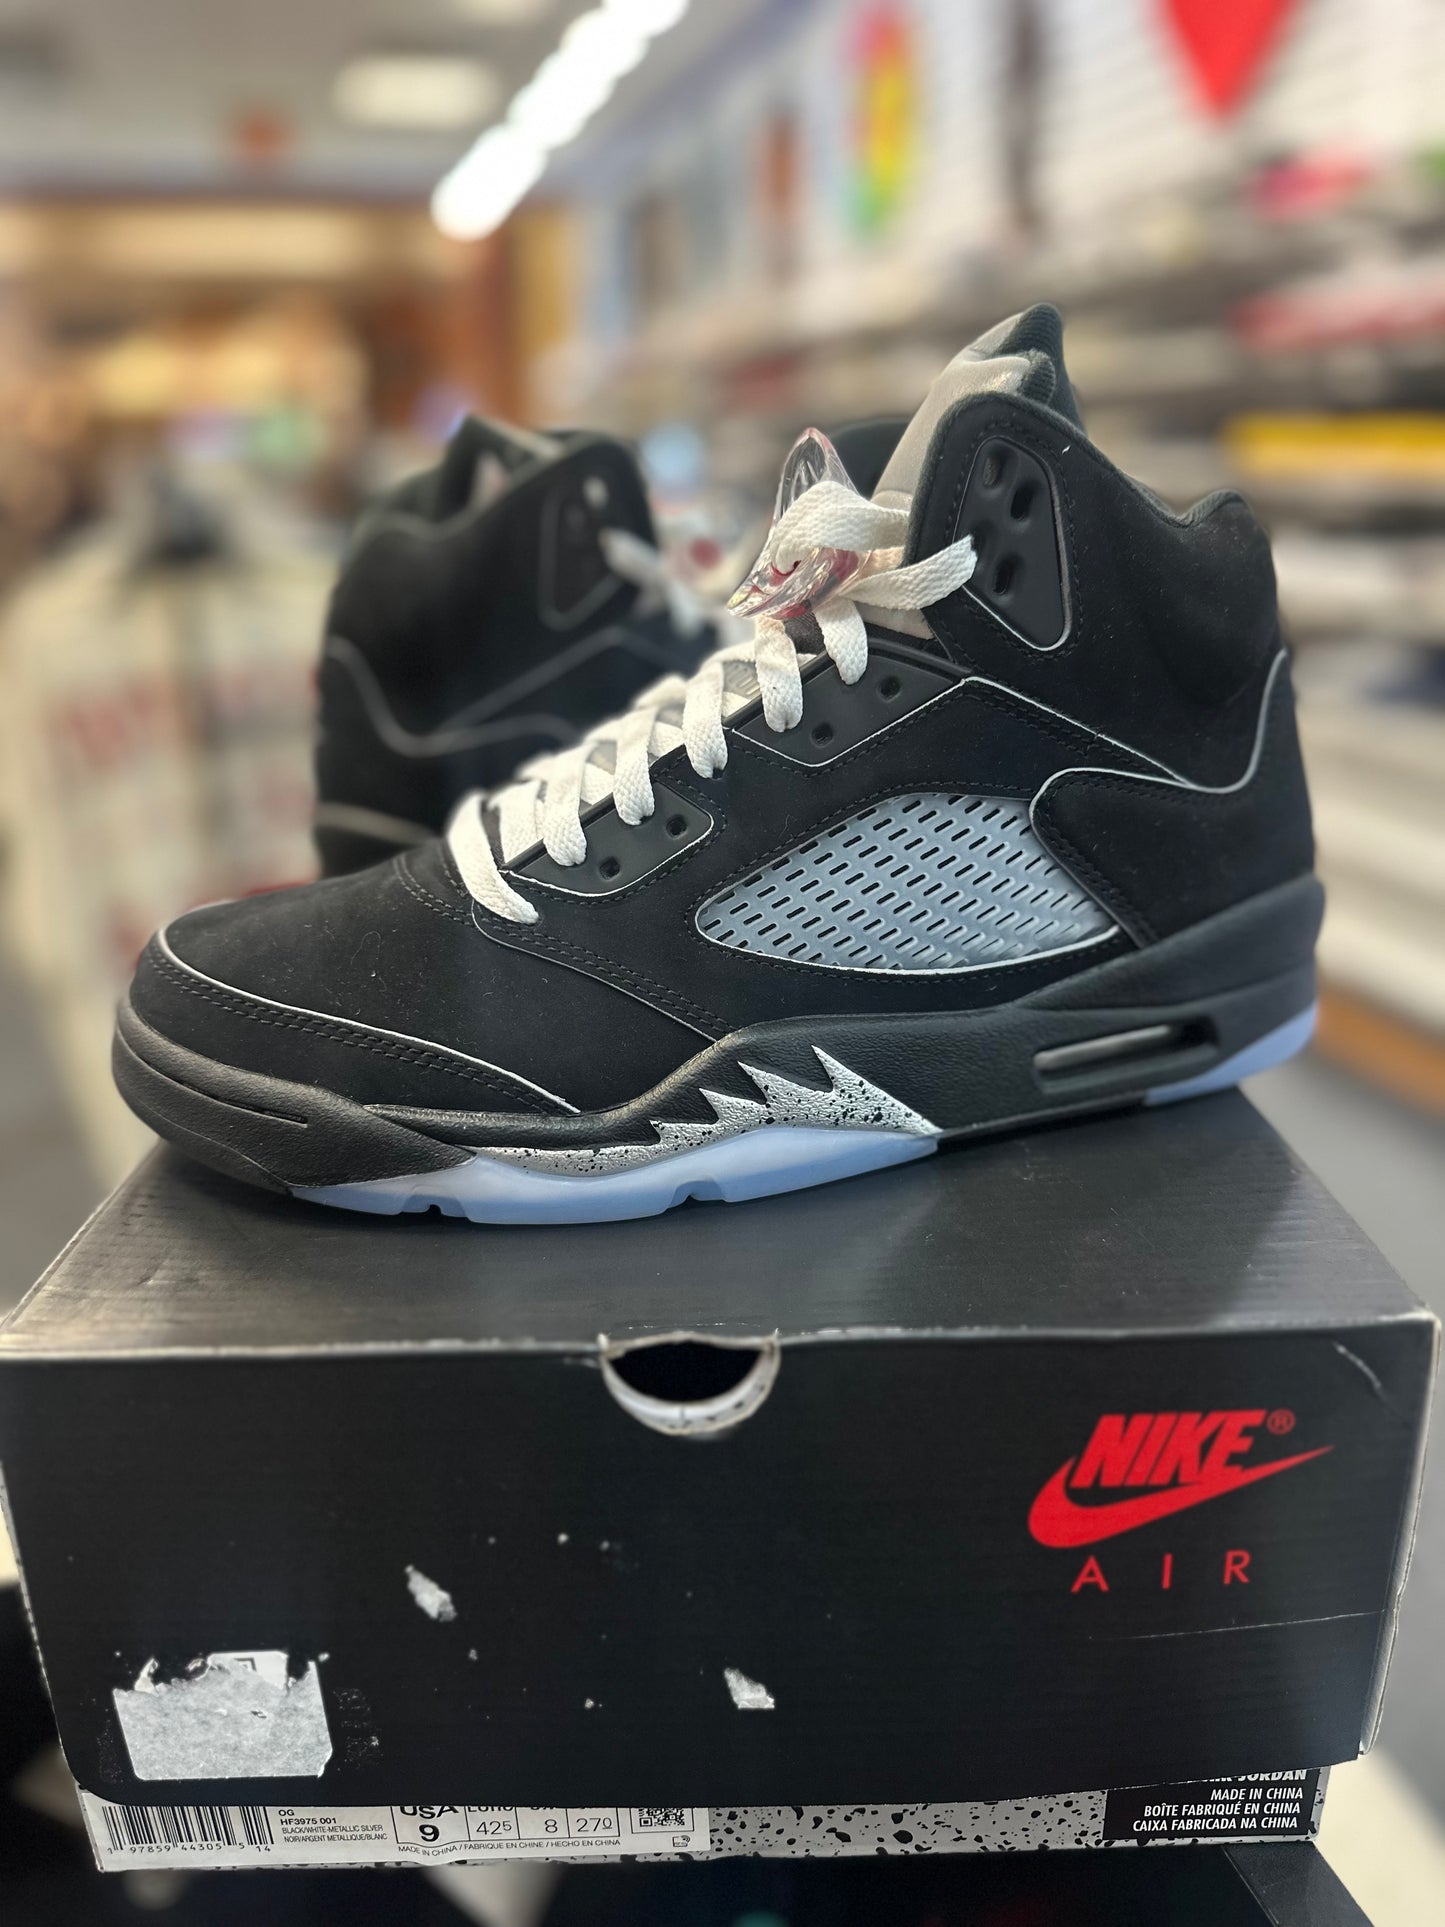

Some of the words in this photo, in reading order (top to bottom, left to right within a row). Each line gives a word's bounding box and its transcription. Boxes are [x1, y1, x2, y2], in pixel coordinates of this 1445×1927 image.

[1069, 1409, 1267, 1488] NIKE
[1070, 1550, 1250, 1593] AIR
[1210, 1788, 1247, 1800] MADE
[1249, 1788, 1263, 1800] IN
[1266, 1787, 1304, 1799] CHINA
[278, 1809, 295, 1817] OG
[1144, 1803, 1179, 1817] BOÎTE
[1181, 1801, 1241, 1816] FABRIQUÉ
[1244, 1803, 1260, 1815] EN
[1263, 1802, 1301, 1814] CHINA
[280, 1818, 318, 1826] HF3975
[319, 1817, 337, 1825] 001
[360, 1824, 384, 1832] SILVER
[544, 1819, 559, 1834] 8
[1133, 1820, 1168, 1832] CAIXA
[1171, 1818, 1237, 1831] FABRICADA
[1240, 1818, 1257, 1829] NA
[1260, 1817, 1298, 1829] CHINA
[418, 1824, 440, 1842] 9
[130, 1844, 171, 1854] 97859
[181, 1843, 222, 1851] 44305
[239, 1842, 245, 1850] 5
[398, 1845, 421, 1854] MADE
[431, 1844, 458, 1857] CHINA
[519, 1841, 544, 1849] CHINE
[551, 1840, 580, 1848] HECHO
[594, 1839, 621, 1847] CHINA
